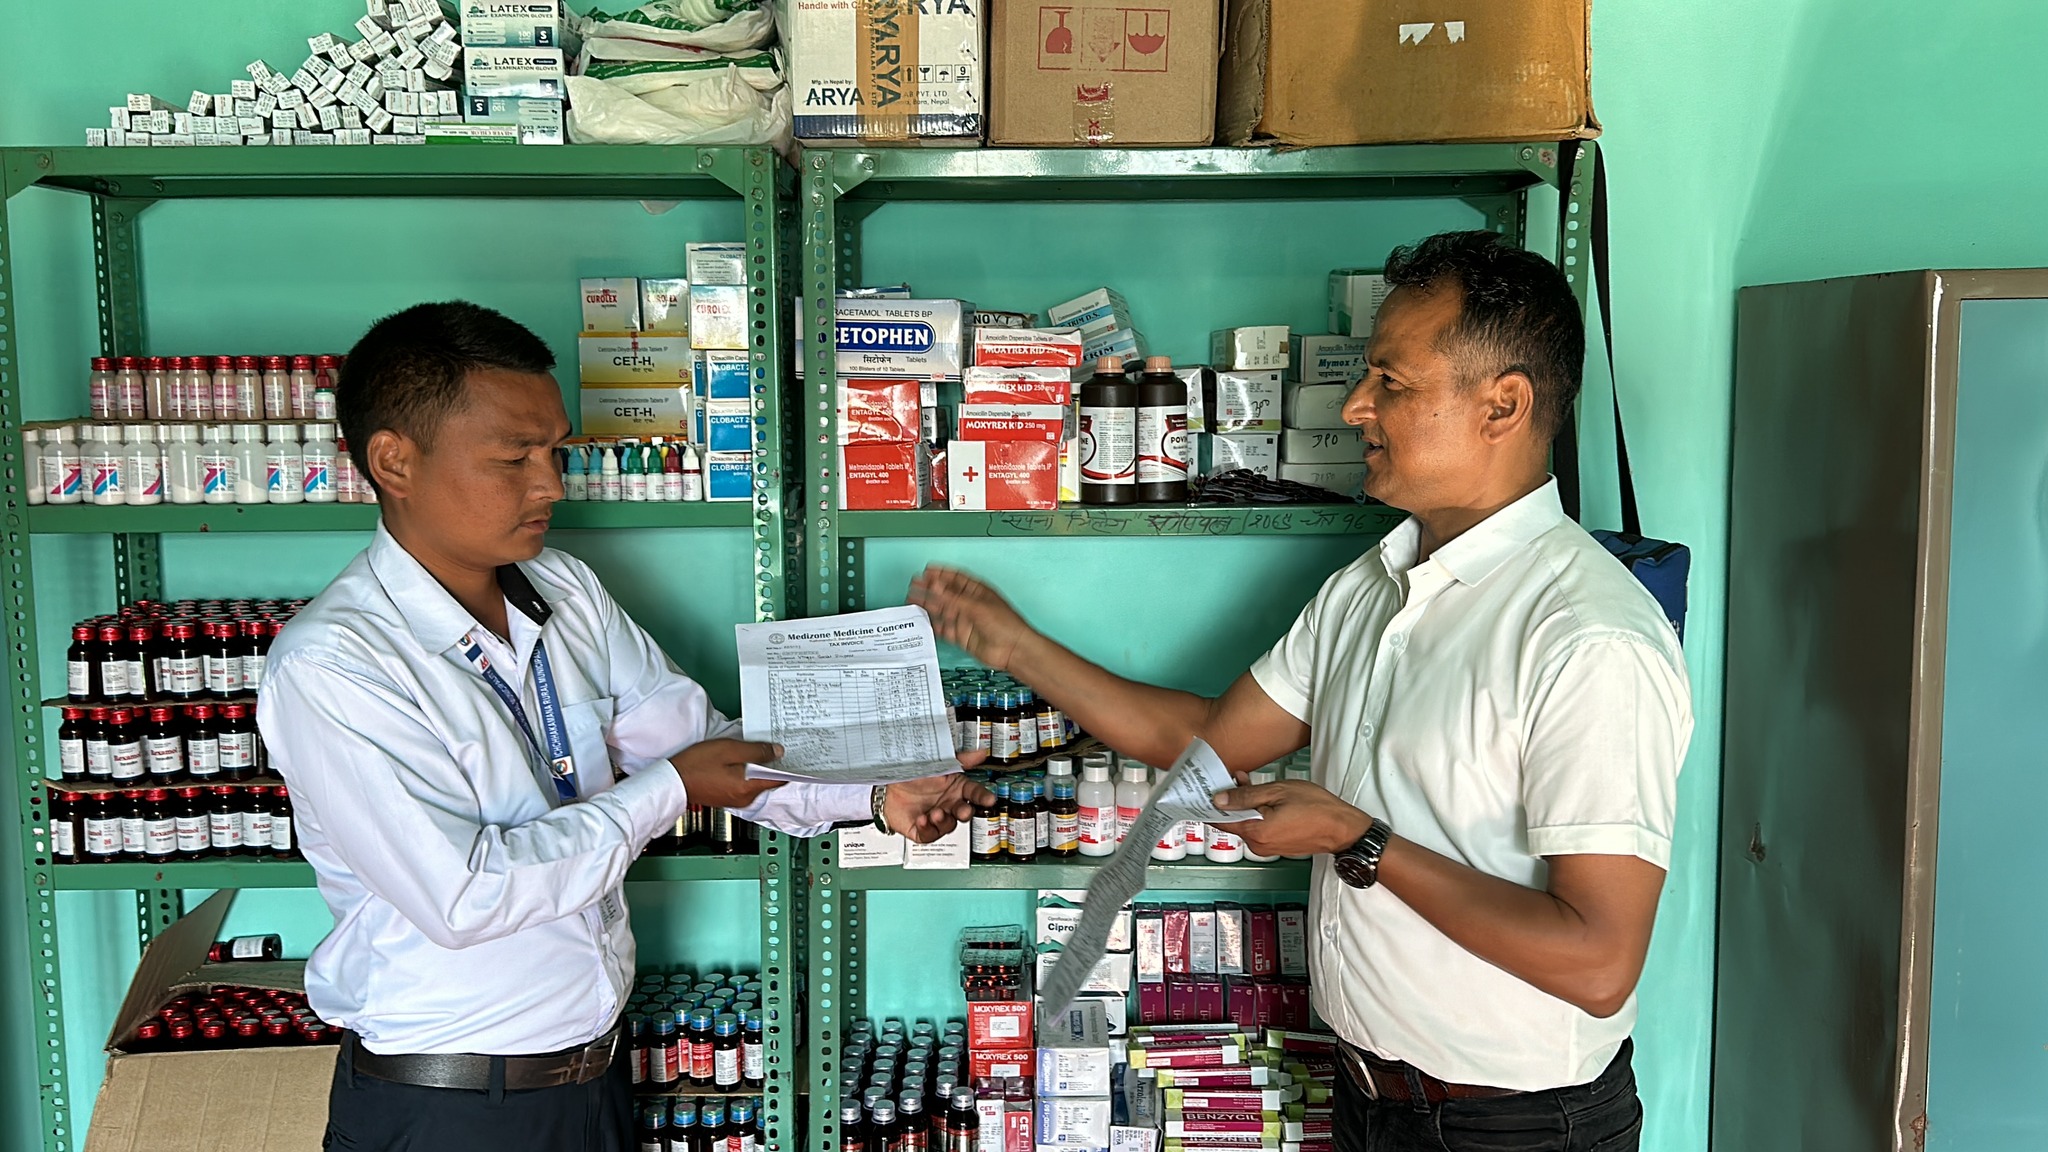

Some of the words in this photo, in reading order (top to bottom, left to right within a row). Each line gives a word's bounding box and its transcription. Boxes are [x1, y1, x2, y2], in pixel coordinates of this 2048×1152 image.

[490, 5, 528, 13] LATEX
[798, 2, 828, 10] Handle
[830, 1, 849, 10] with
[540, 31, 547, 39] S
[494, 57, 531, 65] LATEX
[960, 66, 966, 75] 9
[805, 88, 864, 106] ARYA
[586, 294, 617, 303] CUROLEX
[835, 309, 881, 317] RACETAMOL
[1318, 359, 1350, 369] Mymox
[966, 421, 1008, 429] MOXYREX
[788, 632, 831, 640] Medizone
[833, 628, 874, 637] Medicine
[876, 621, 915, 633] Concern
[542, 682, 551, 704] RURAL
[1255, 952, 1263, 971] CET
[1019, 1116, 1029, 1137] CET
